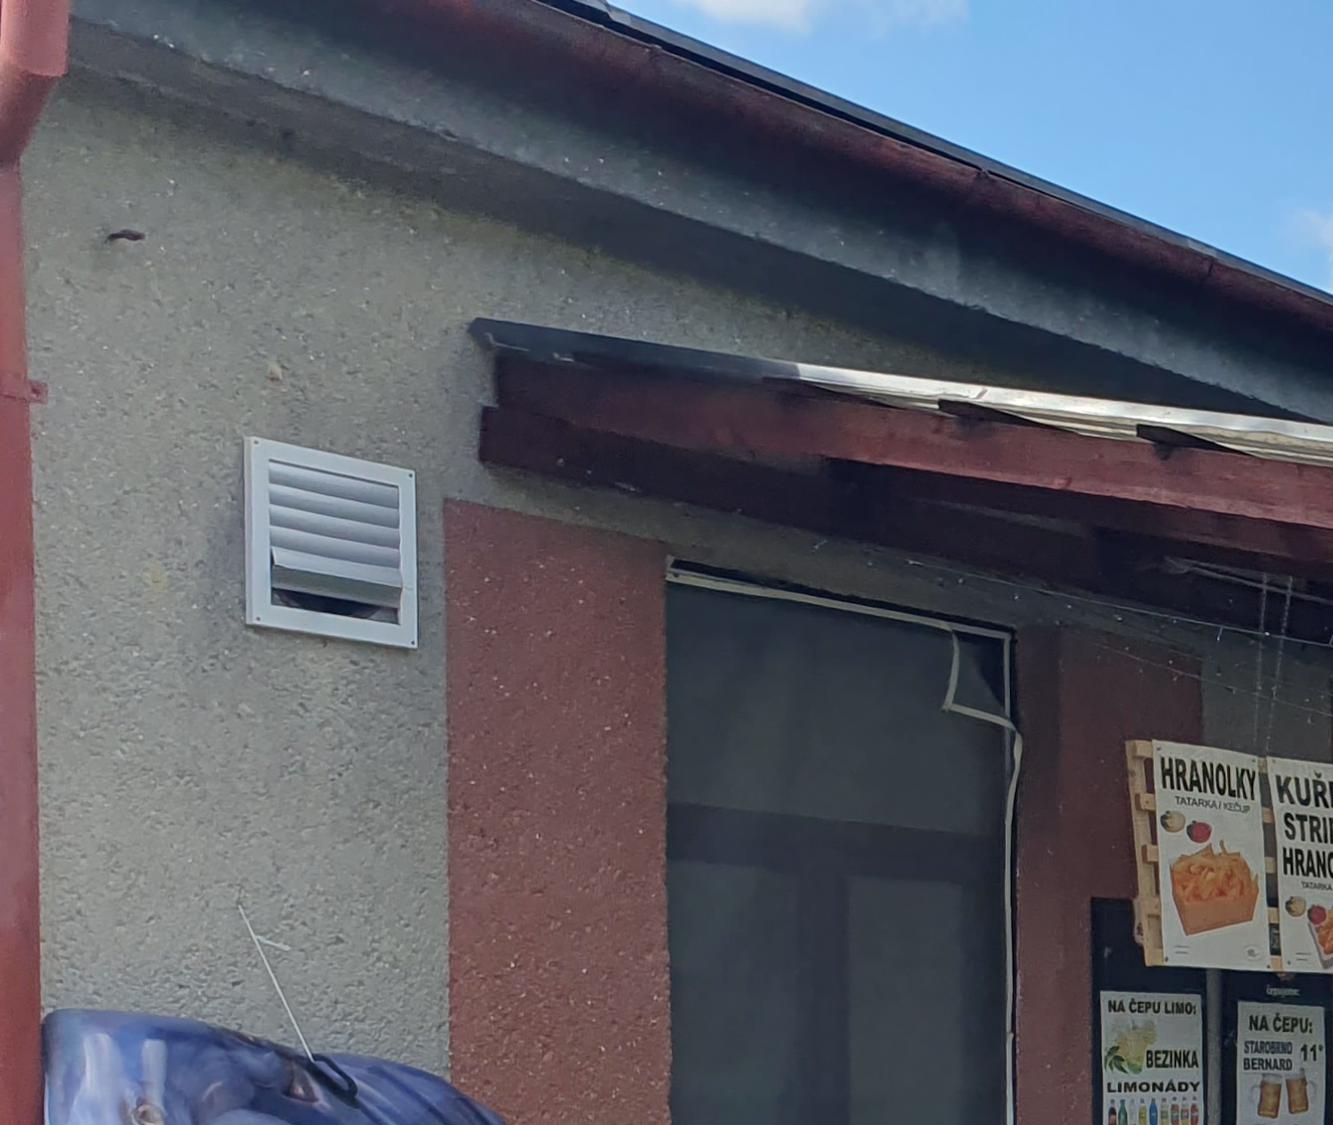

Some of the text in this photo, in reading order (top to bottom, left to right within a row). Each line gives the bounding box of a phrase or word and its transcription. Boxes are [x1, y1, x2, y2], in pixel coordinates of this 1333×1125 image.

[1160, 756, 1256, 801] HRANOLKY
[1175, 796, 1217, 810] TATARKA
[1108, 998, 1197, 1015] NA ČEPU LIMO:
[1248, 1012, 1313, 1034] NA ČEPU:
[1146, 1049, 1199, 1069] BEZINKA
[1243, 1057, 1293, 1071] BERNARD
[1107, 1078, 1200, 1093] LIMONÁDY
